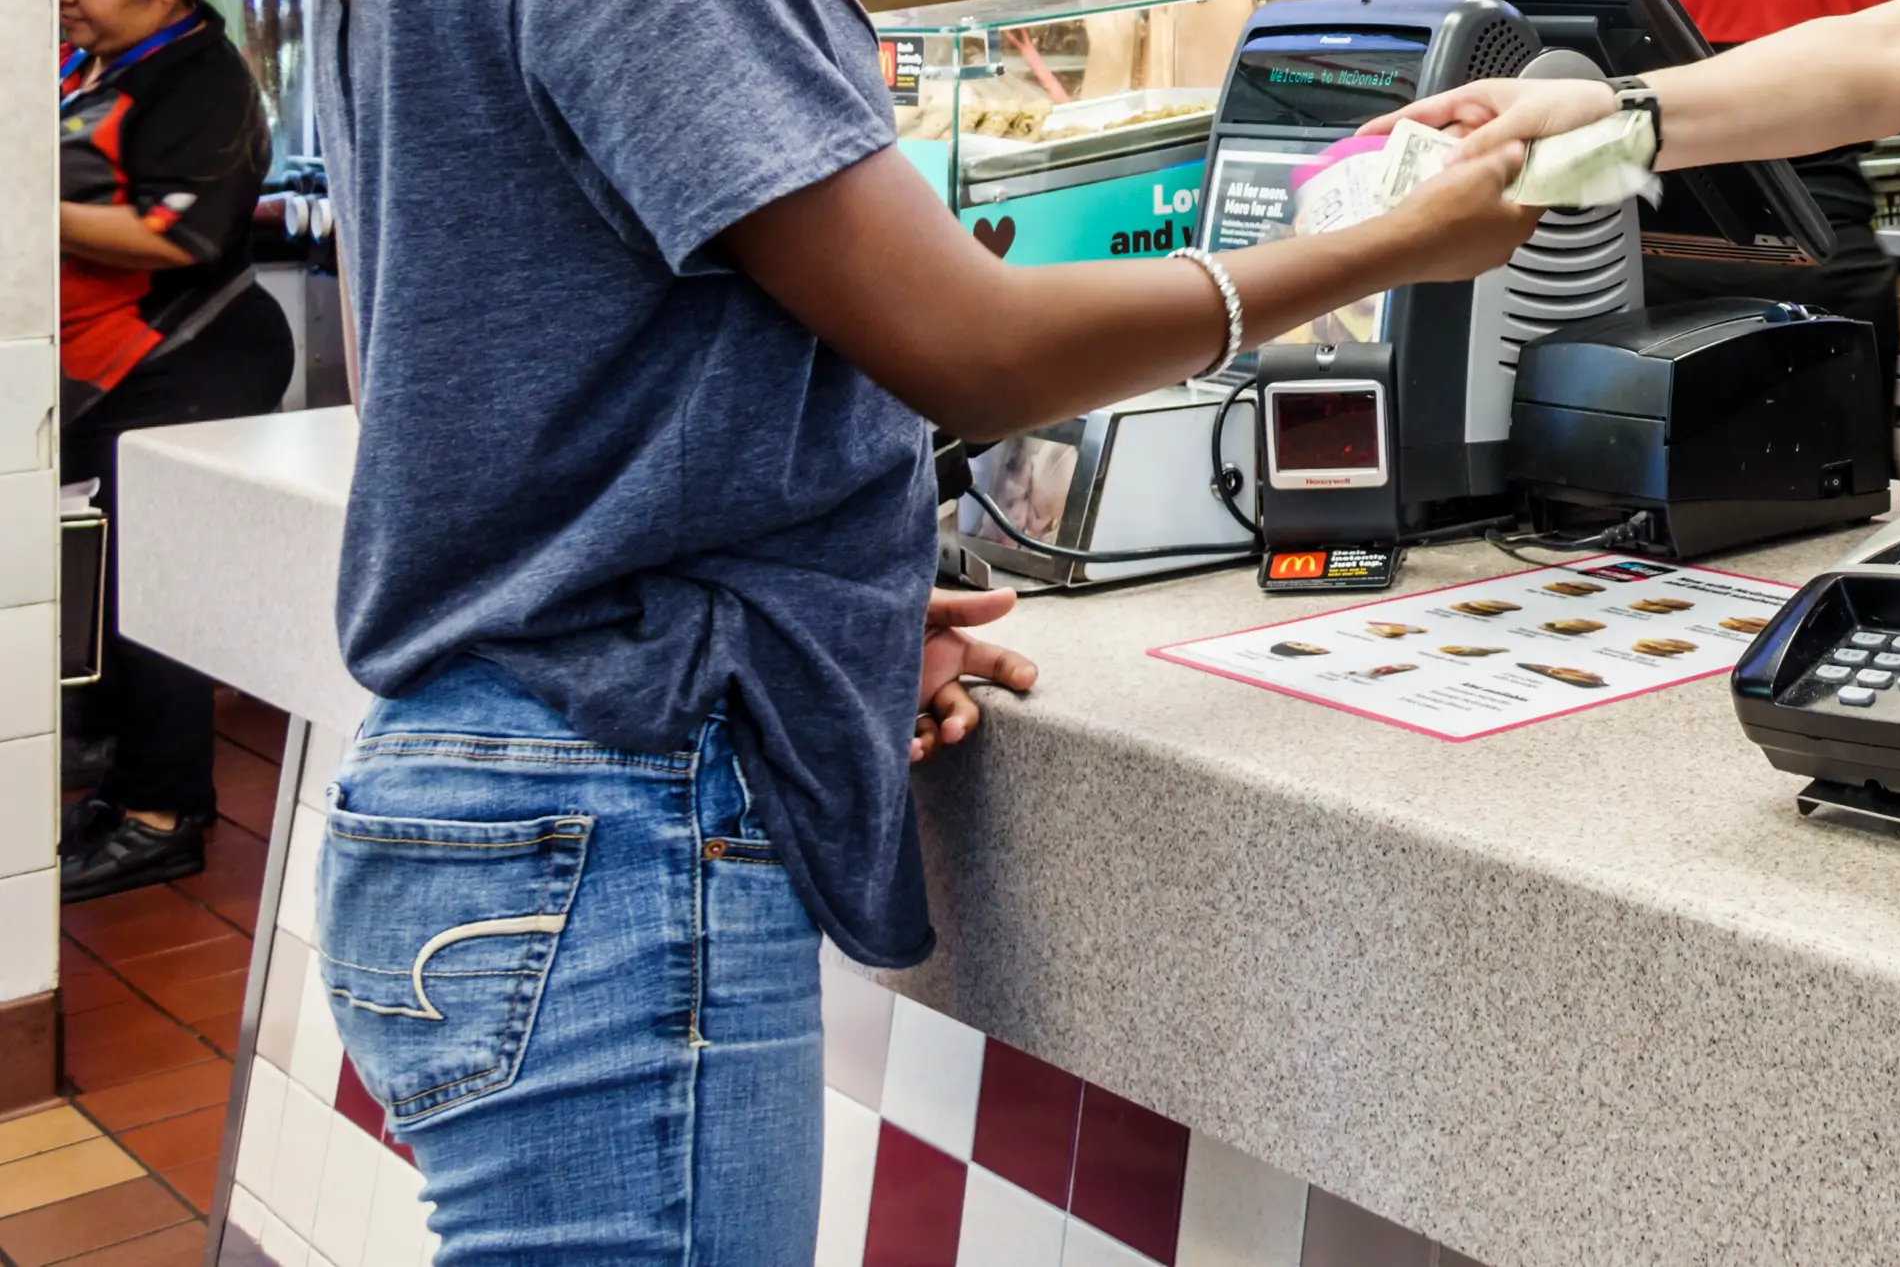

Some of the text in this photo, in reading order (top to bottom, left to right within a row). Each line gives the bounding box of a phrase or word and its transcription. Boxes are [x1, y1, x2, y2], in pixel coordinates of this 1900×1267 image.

[1269, 68, 1314, 83] Welcome
[1321, 70, 1332, 84] to
[1227, 182, 1243, 197] All
[1259, 187, 1288, 201] more.
[1224, 198, 1283, 217] More for all.
[1110, 220, 1173, 256] and
[1306, 478, 1351, 486] Honeywell
